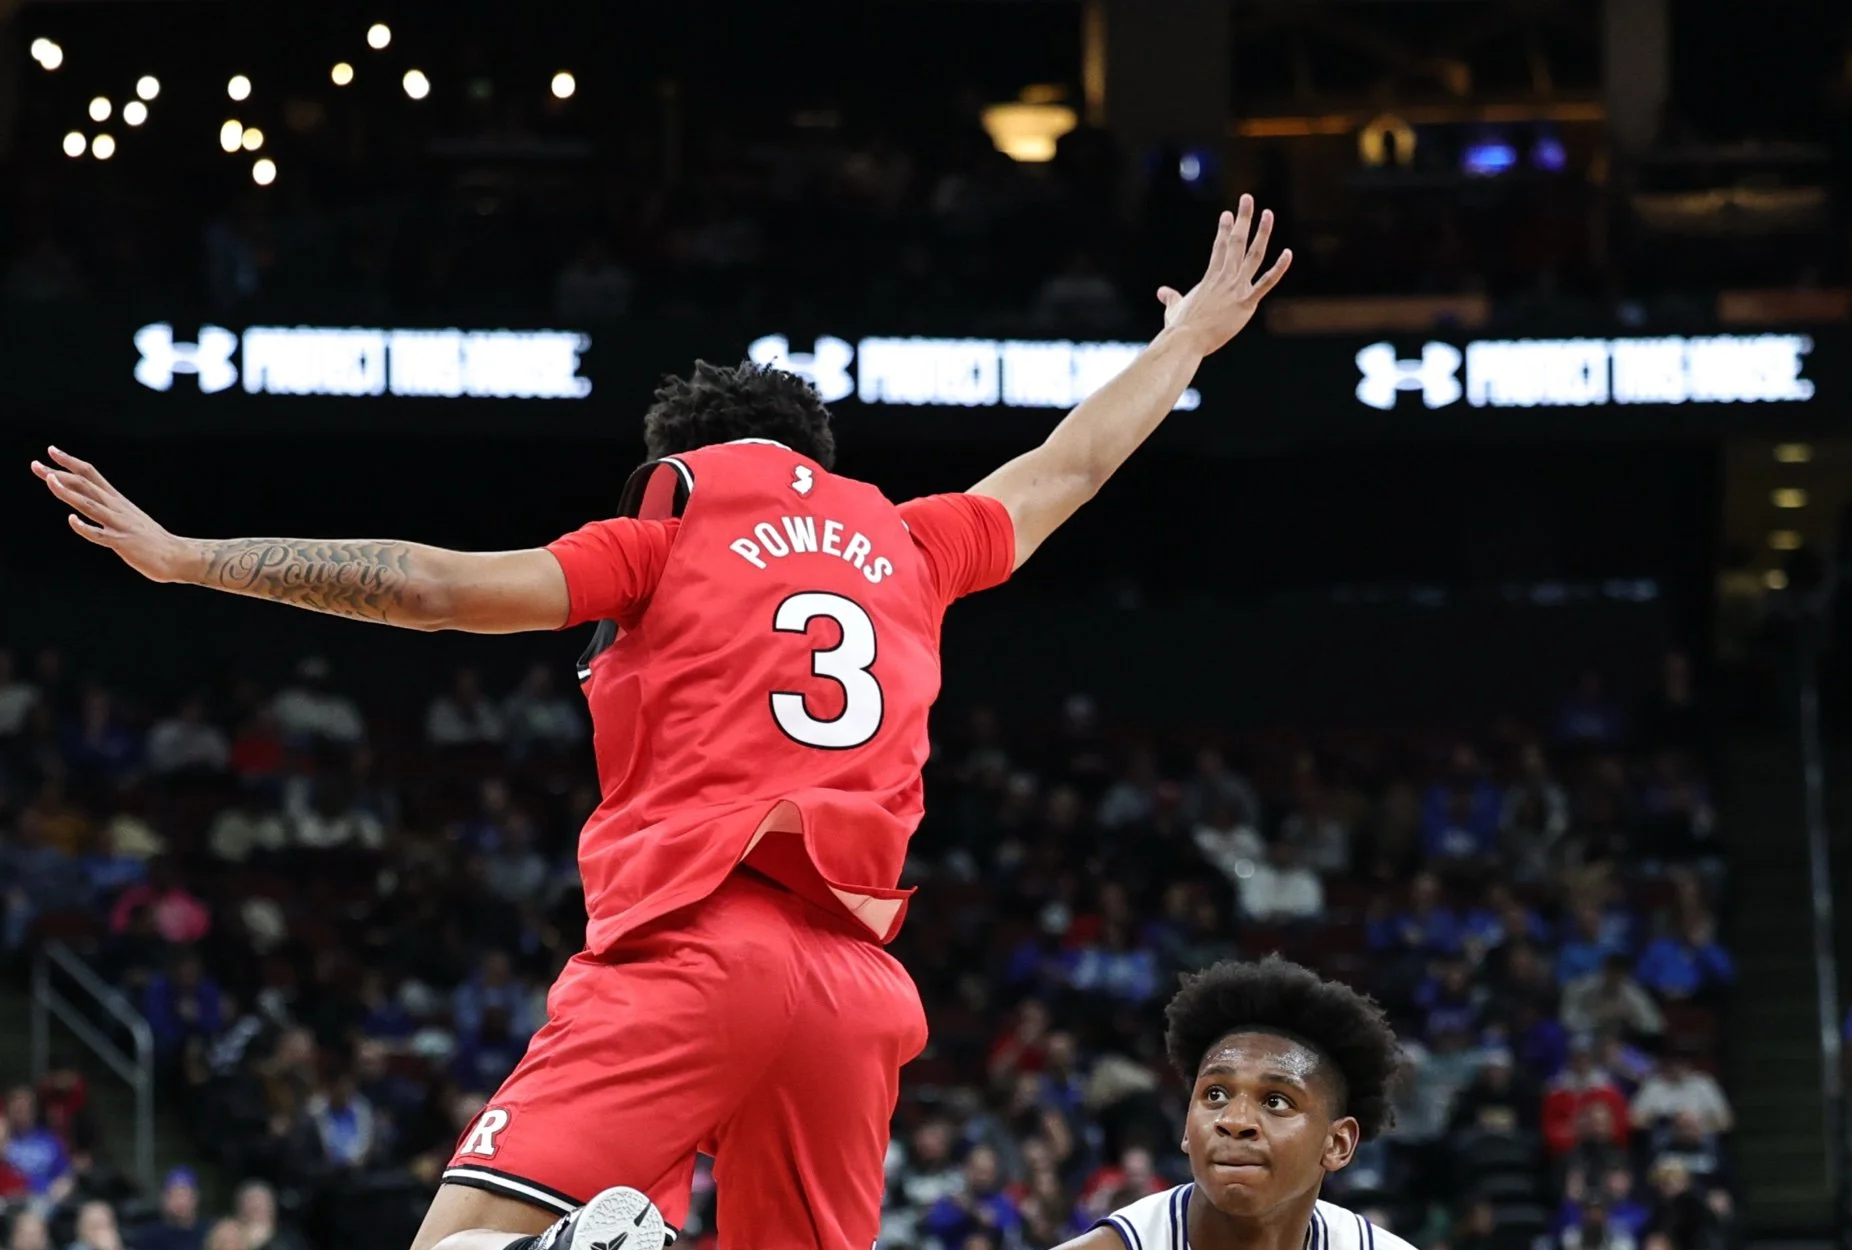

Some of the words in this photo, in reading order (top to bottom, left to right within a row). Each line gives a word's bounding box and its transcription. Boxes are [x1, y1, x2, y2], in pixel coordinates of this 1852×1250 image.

[220, 545, 389, 590] Powers
[729, 516, 893, 584] POWERS
[769, 590, 885, 750] 3
[459, 1107, 511, 1156] R
